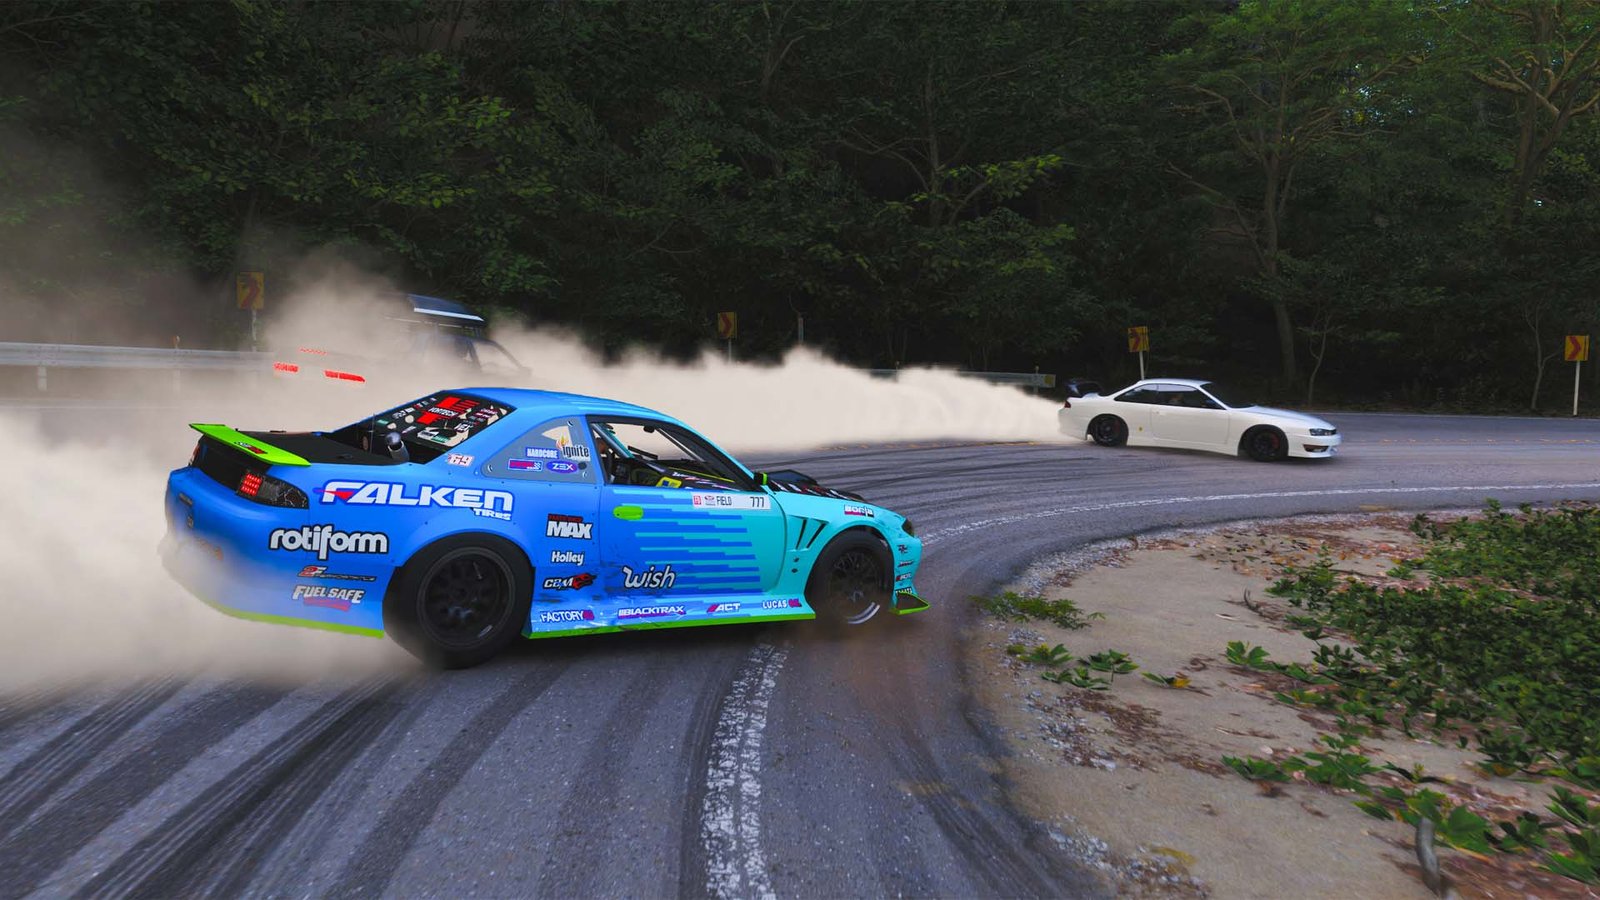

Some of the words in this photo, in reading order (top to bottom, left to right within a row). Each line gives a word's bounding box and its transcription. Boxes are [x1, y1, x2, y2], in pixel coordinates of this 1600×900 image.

[526, 448, 558, 458] HARDCORE
[552, 462, 574, 471] ZEX
[321, 481, 514, 512] FALKEN
[716, 495, 733, 506] FIELD
[749, 496, 765, 508] 777
[473, 508, 511, 521] TIRES
[546, 520, 593, 539] MAX
[270, 525, 388, 560] rotiform
[551, 551, 585, 566] Holley
[292, 585, 326, 600] FUEL
[327, 587, 365, 604] SAFE
[621, 605, 685, 616] BLACKTRAX
[714, 602, 741, 612] ACT
[762, 599, 788, 609] LUCAS
[540, 610, 584, 622] FACTORY
